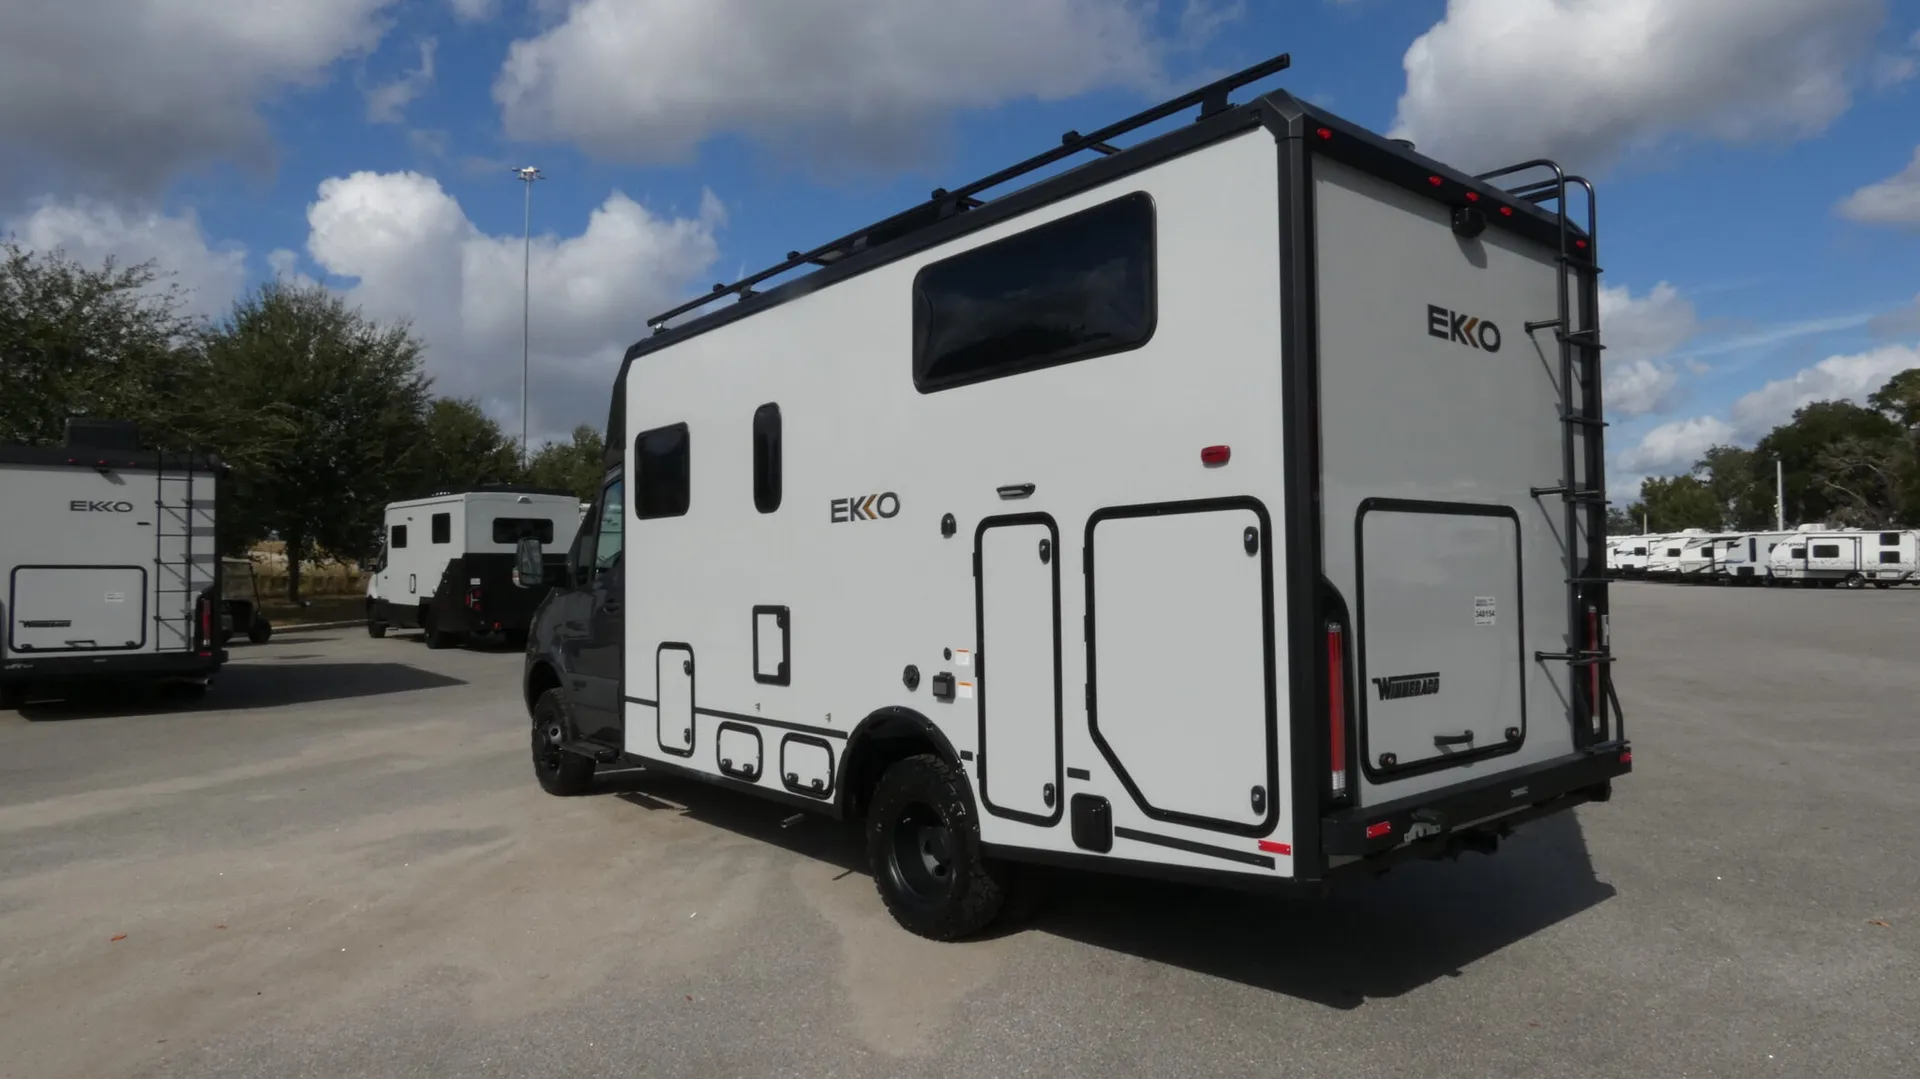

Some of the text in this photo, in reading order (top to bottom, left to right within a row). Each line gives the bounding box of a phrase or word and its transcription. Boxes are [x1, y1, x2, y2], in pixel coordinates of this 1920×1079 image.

[1428, 303, 1501, 353] EKKO
[70, 500, 133, 512] EKKO
[830, 491, 900, 523] EKKO
